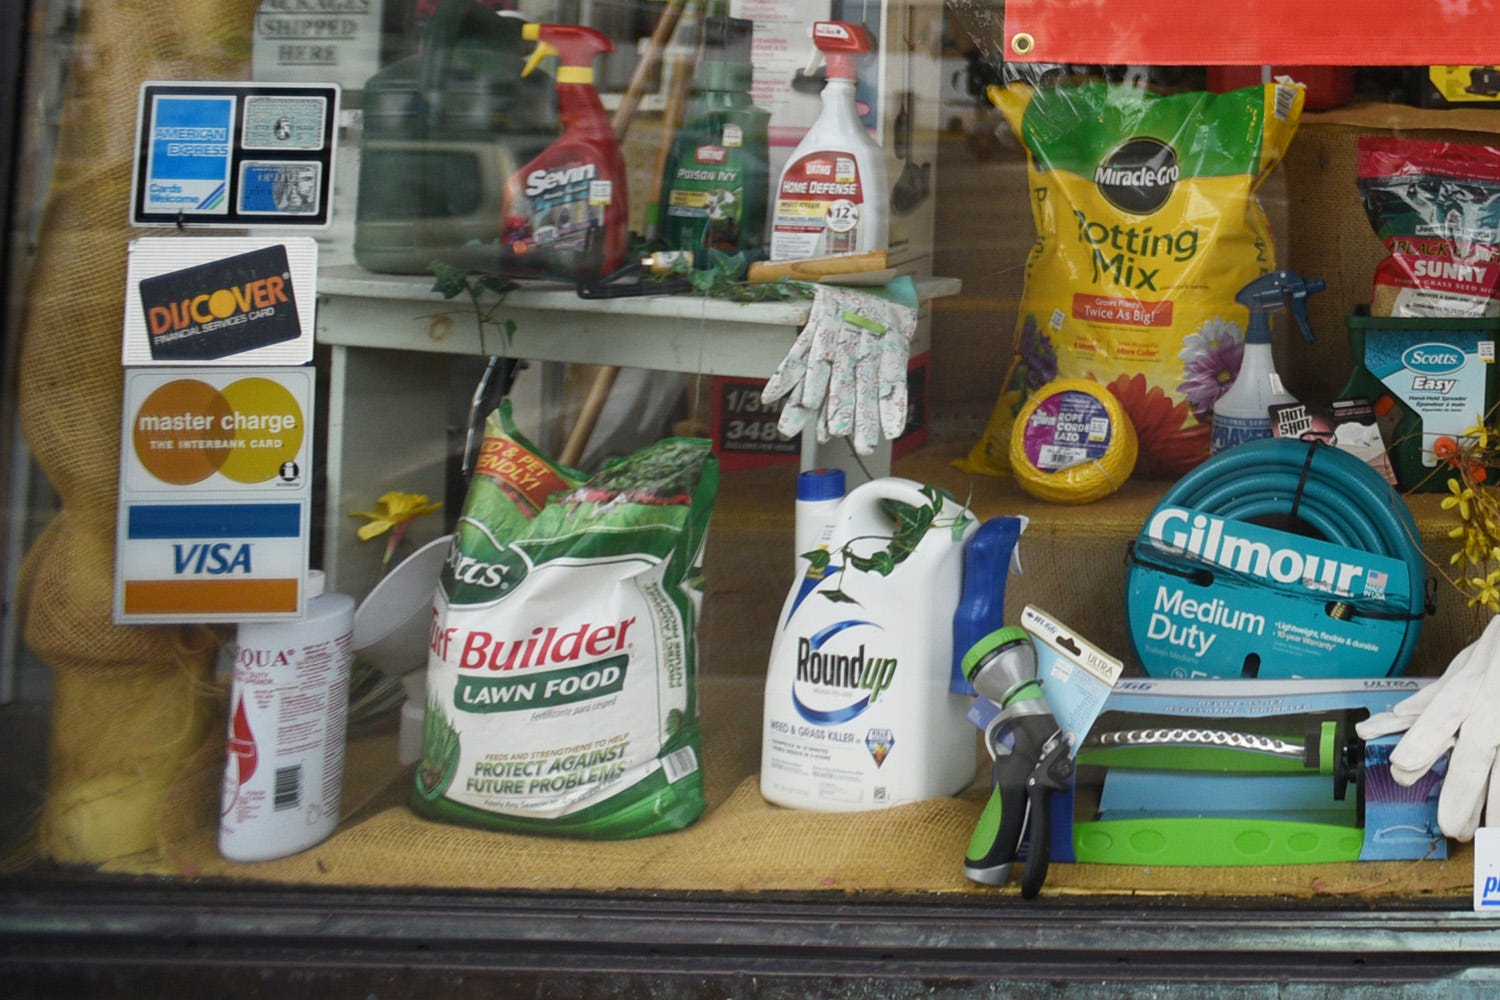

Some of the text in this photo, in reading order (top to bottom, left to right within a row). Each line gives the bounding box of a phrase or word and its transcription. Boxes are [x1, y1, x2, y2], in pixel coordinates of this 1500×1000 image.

[262, 19, 358, 36] SHIPPED
[278, 45, 337, 61] HERE
[155, 127, 226, 141] AMERICAN
[168, 143, 229, 157] EXPRESS
[525, 163, 595, 197] Sevin
[677, 168, 737, 182] POISON IVY
[1094, 163, 1180, 187] Miracle-Gro
[151, 183, 181, 193] Cards
[783, 181, 857, 195] HOME DEFENSE
[151, 195, 199, 204] Welcome
[835, 207, 850, 219] 12
[1074, 209, 1199, 263] Potting
[1092, 249, 1160, 292] Mix
[1414, 260, 1487, 284] SUNNY
[150, 276, 288, 334] DISCOVER
[1084, 305, 1156, 325] Twice As Big!
[154, 307, 275, 345] FINANCIAL SERVICES CARD
[1411, 351, 1458, 365] Scotts
[1412, 376, 1456, 395] Easy
[139, 412, 296, 433] master charge
[1058, 412, 1084, 423] ROPE
[1279, 406, 1306, 424] HOT
[1054, 431, 1080, 442] LAZO
[1279, 418, 1313, 437] SHOT
[150, 439, 282, 449] THE INTERBANK CARD
[517, 455, 551, 477] PET
[173, 543, 252, 575] VISA
[1147, 507, 1363, 597] Gilmour
[1153, 585, 1266, 636] Medium
[459, 615, 636, 671] Builder
[1147, 613, 1216, 656] Duty
[1278, 622, 1319, 639] Lightweight,
[1352, 640, 1379, 653] durable
[797, 636, 898, 702] Roundup
[1087, 652, 1114, 677] ULTRA
[462, 665, 621, 705] LAWN FOOD
[1363, 680, 1420, 690] ULTRA
[770, 721, 855, 743] WEED & GRASS KILLER
[474, 741, 631, 778] PROTECT AGAINST
[466, 760, 628, 795] FUTURE PROBLEMS
